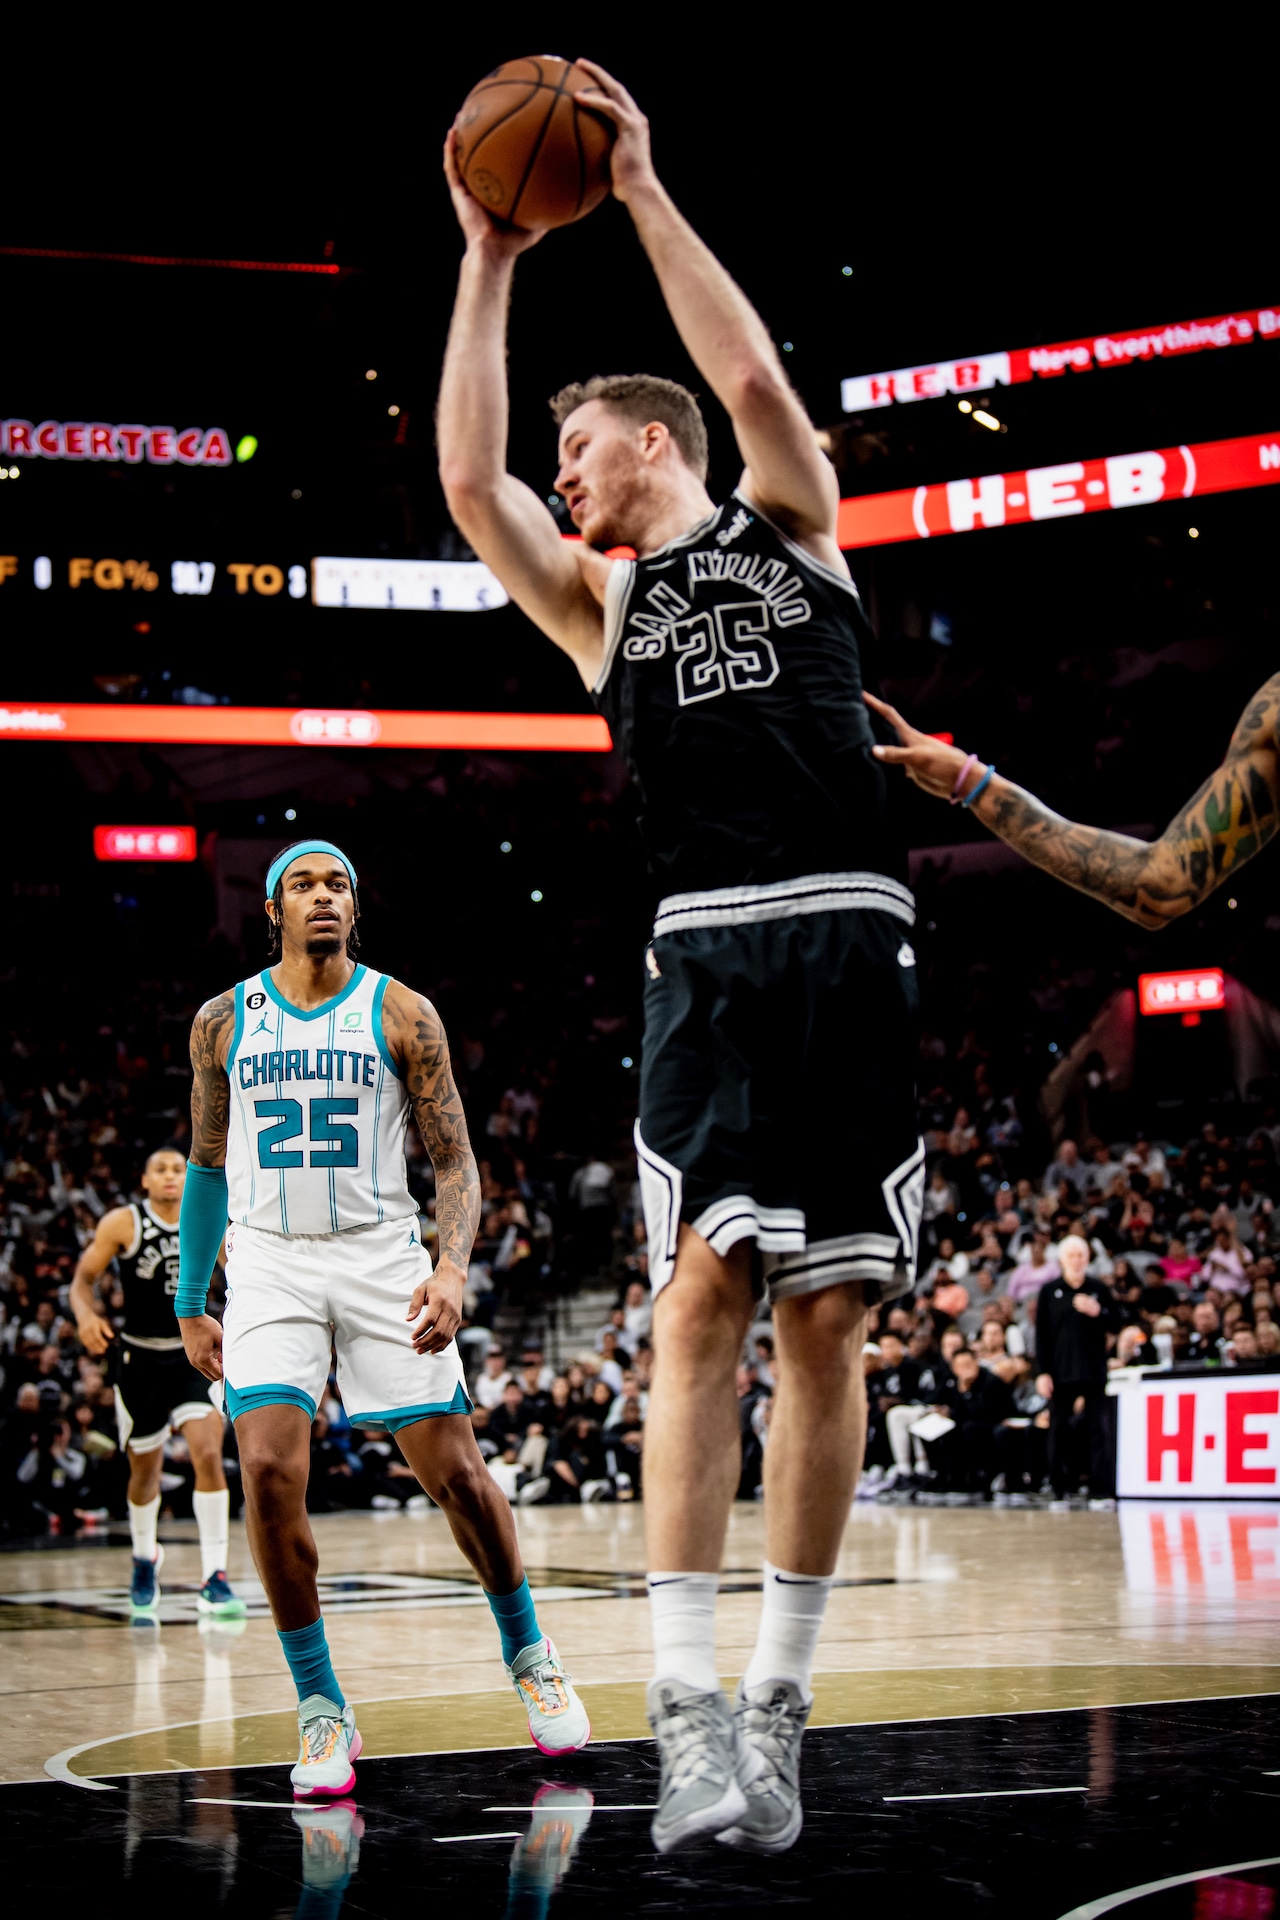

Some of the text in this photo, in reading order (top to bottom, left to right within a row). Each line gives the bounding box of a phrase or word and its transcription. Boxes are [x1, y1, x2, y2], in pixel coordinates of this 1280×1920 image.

[0, 418, 234, 467] RGERTECA
[68, 557, 159, 592] FG%
[226, 563, 284, 596] TO
[623, 549, 812, 661] SAN NTONIO
[671, 601, 780, 706] 25
[250, 995, 263, 1008] 6
[238, 1048, 376, 1090] CHARLOTTE
[254, 1097, 359, 1169] 25
